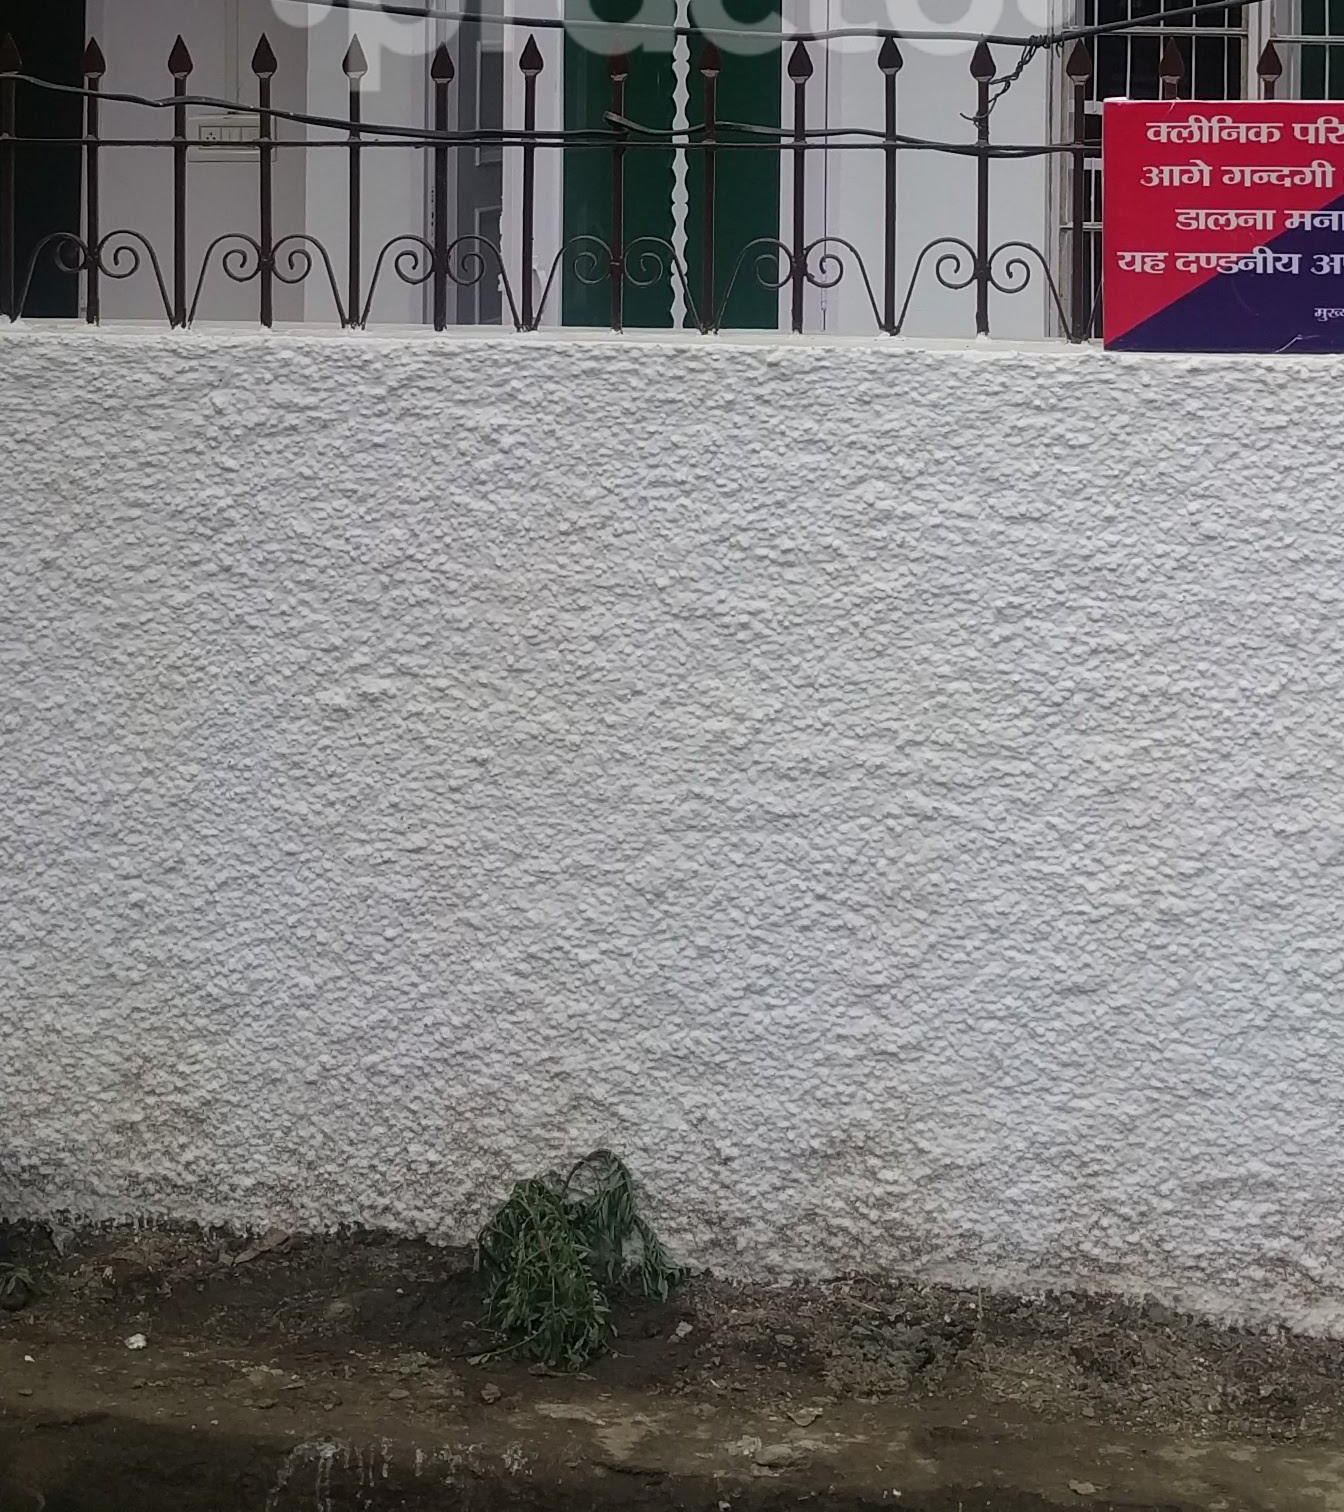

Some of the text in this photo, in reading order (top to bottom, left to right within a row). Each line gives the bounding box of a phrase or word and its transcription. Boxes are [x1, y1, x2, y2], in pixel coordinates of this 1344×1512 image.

[1146, 115, 1284, 143] क्लीनिक
[1140, 160, 1212, 186] आगे
[1221, 160, 1336, 187] गन्दगी
[1175, 209, 1276, 230] डालना
[1117, 252, 1168, 273] यह
[1174, 246, 1302, 274] दण्डनीय
